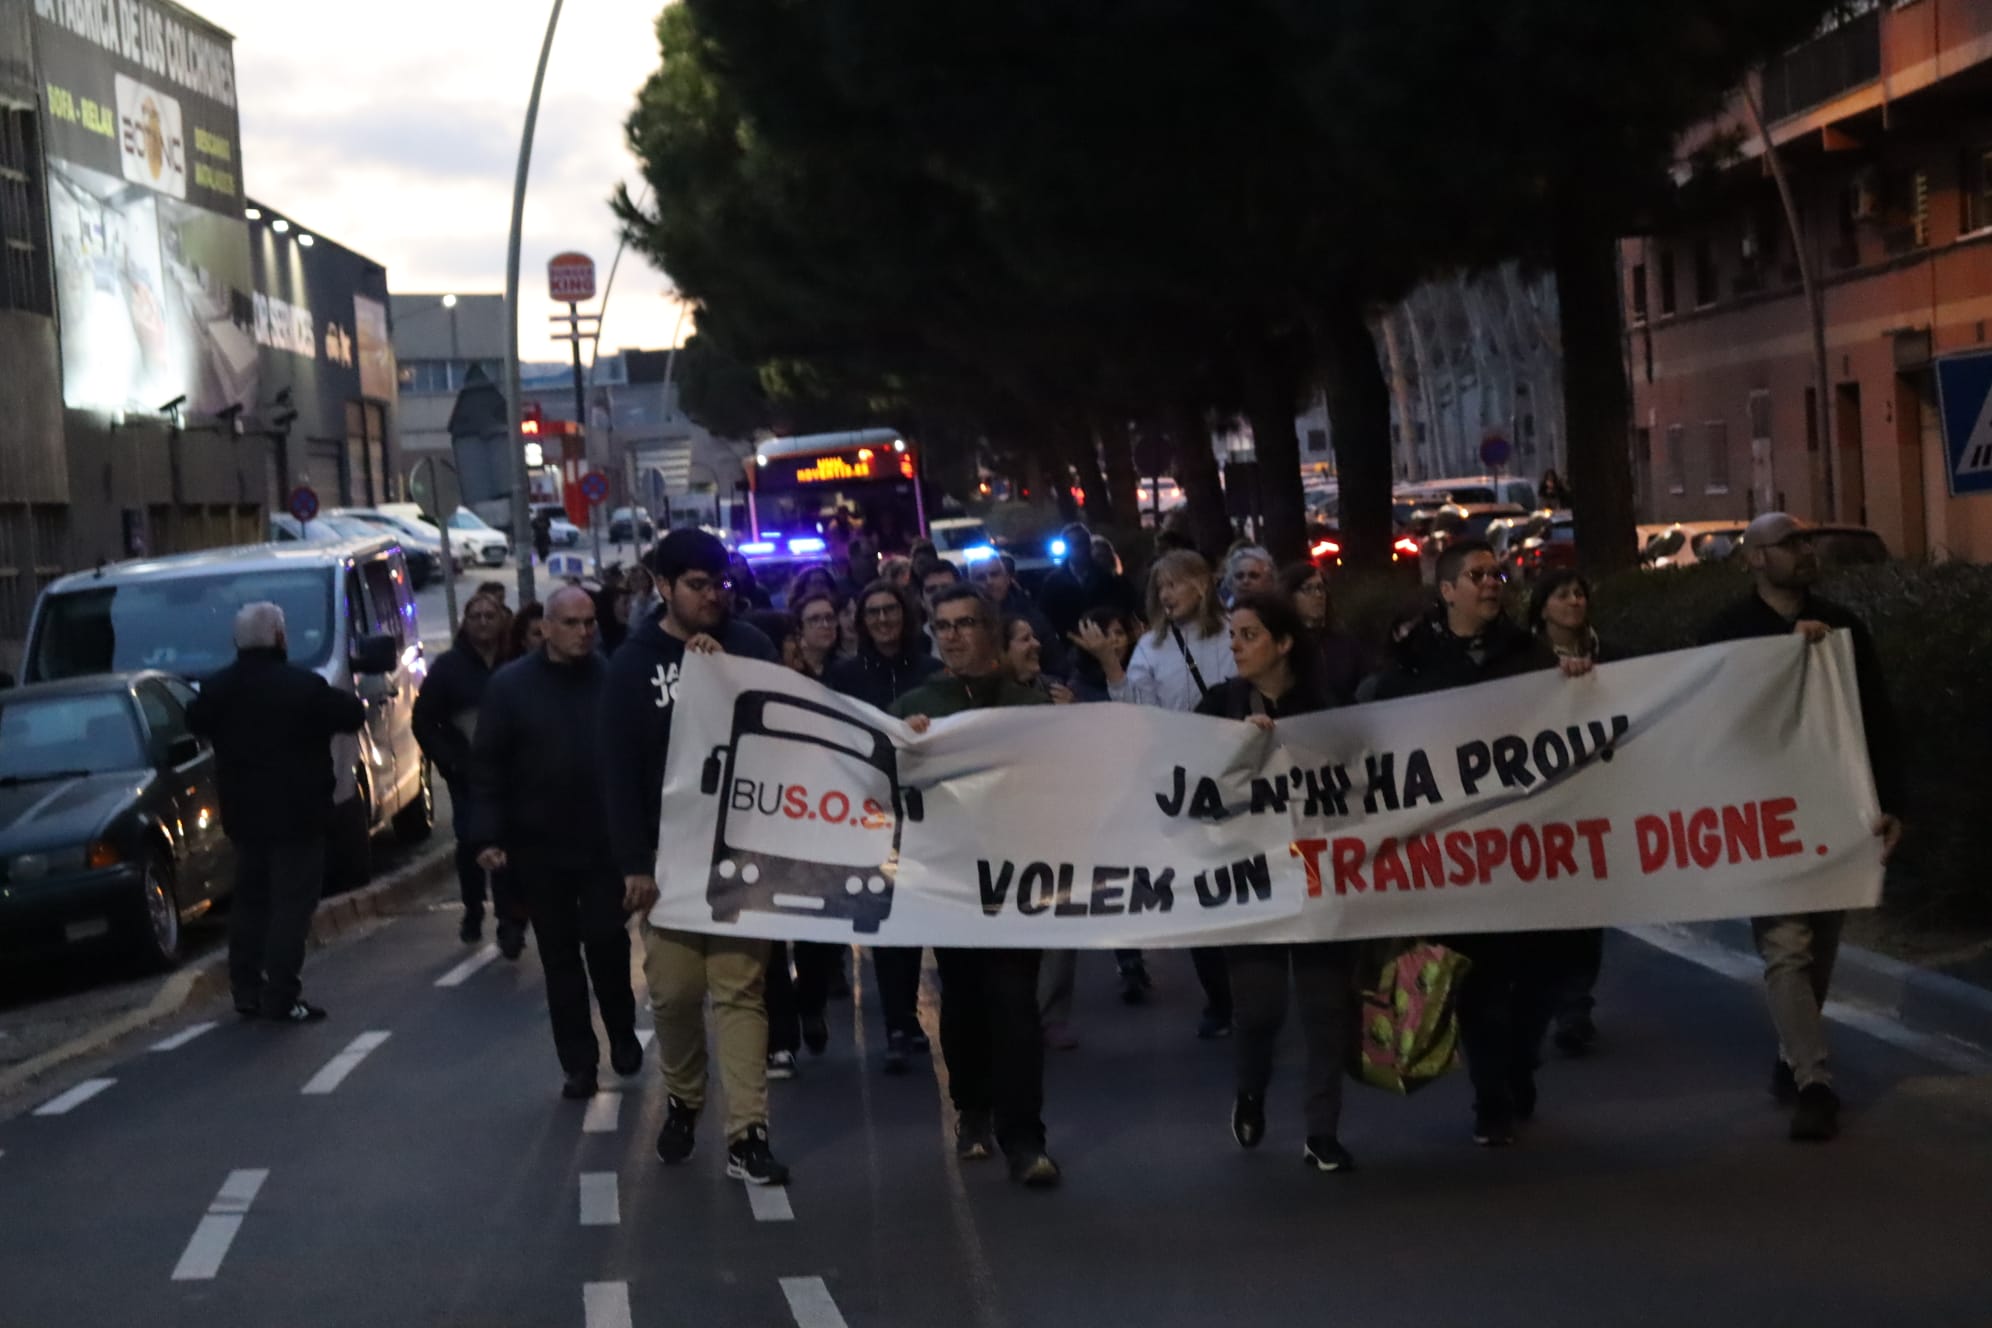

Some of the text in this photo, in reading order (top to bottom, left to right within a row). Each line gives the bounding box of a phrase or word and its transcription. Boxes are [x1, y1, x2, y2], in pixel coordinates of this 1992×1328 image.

[550, 278, 593, 291] KING
[1155, 765, 1231, 820] JA
[1364, 748, 1444, 814] HA
[977, 859, 1176, 918] VOLEM
[1194, 853, 1272, 909] UN
[1289, 818, 1612, 898] TRANSPORT
